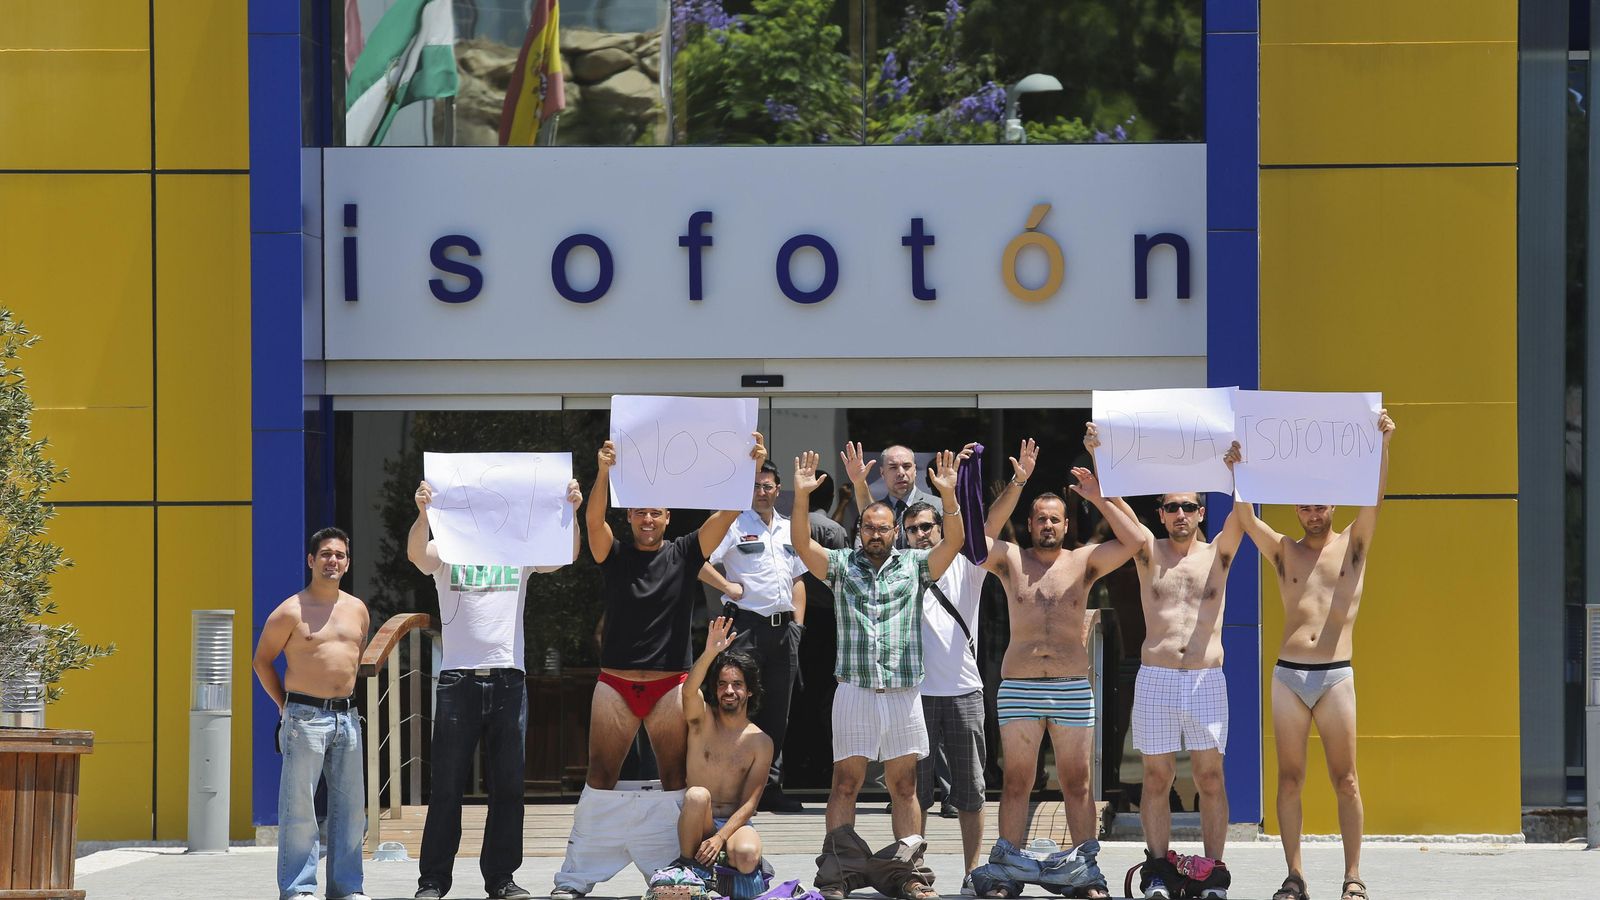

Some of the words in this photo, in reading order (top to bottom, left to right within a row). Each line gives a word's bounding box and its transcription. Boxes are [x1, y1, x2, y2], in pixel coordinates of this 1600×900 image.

[343, 203, 1192, 304] isofotón
[619, 419, 738, 488] NOS
[1106, 410, 1217, 470] DEJA
[1239, 415, 1376, 464] ISOFOTON
